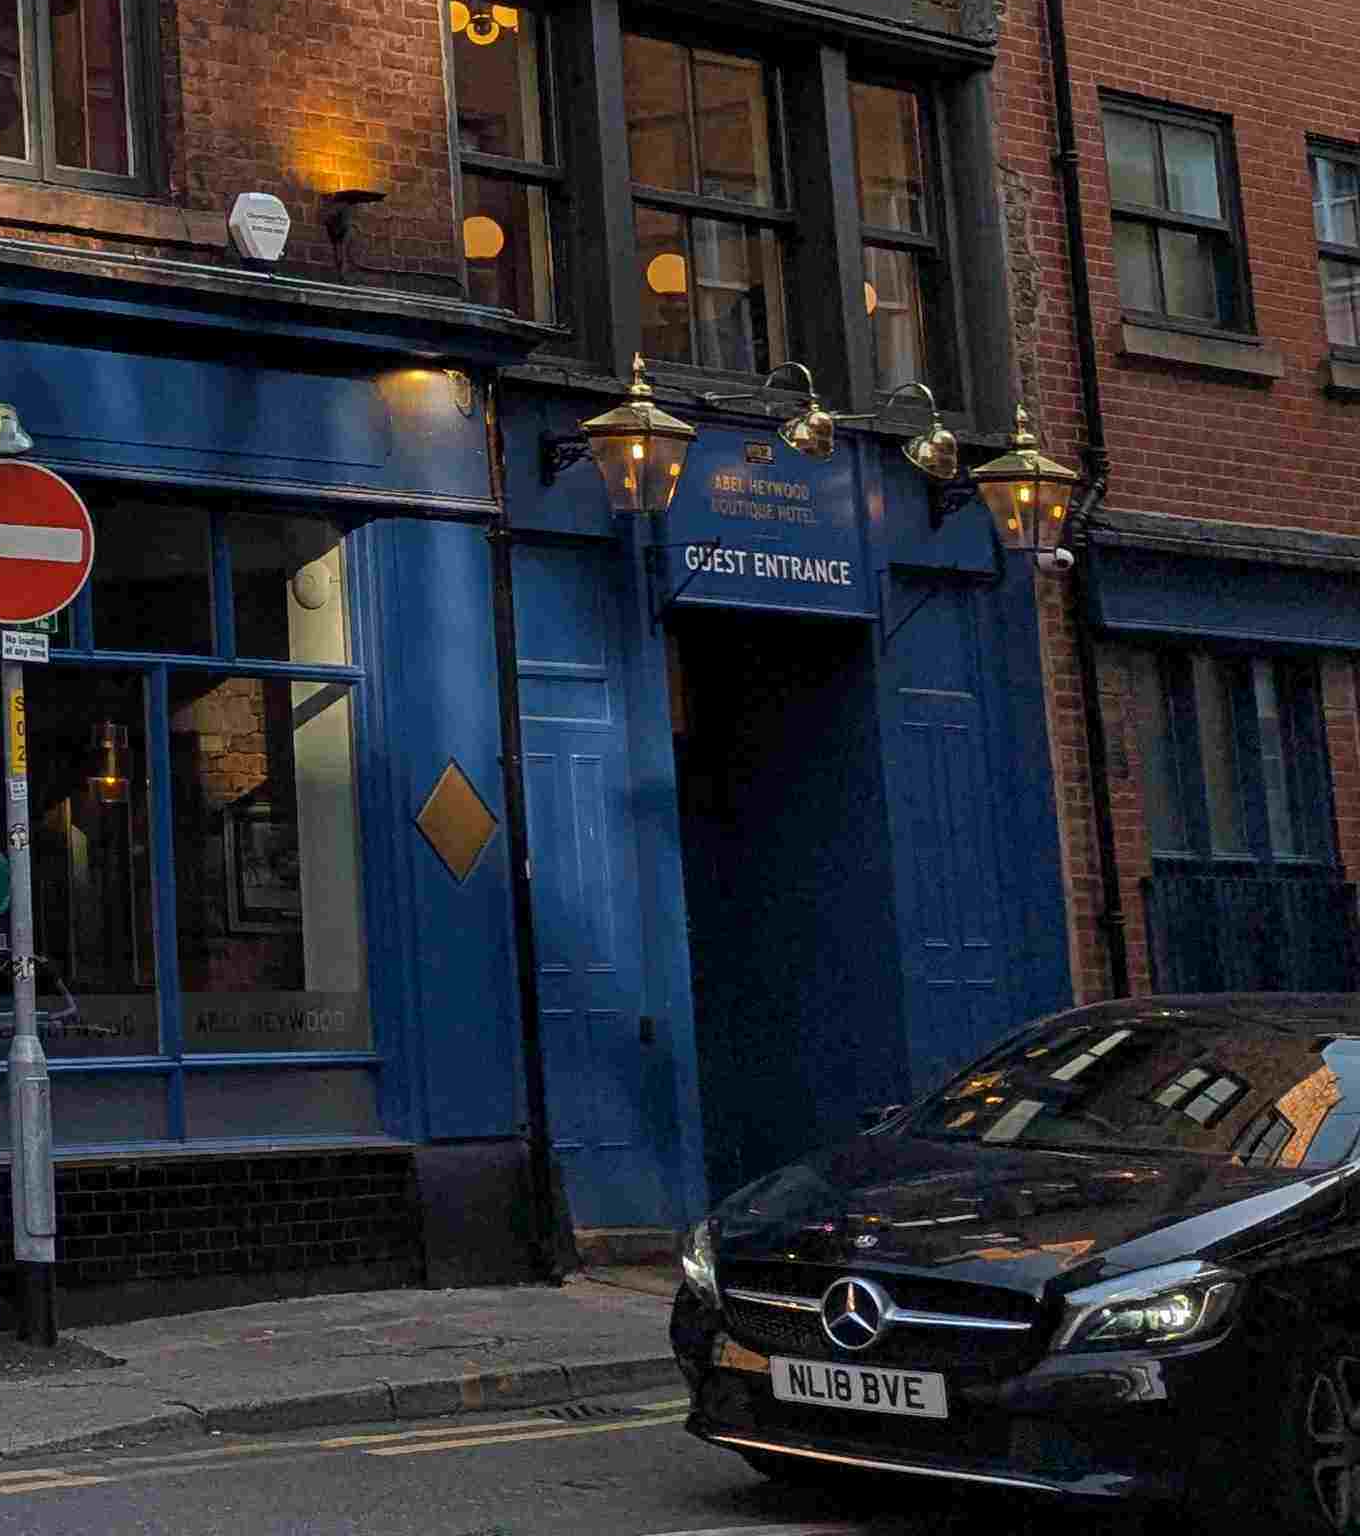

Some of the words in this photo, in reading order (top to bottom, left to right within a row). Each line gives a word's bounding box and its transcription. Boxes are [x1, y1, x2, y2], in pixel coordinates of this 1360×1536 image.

[712, 472, 745, 494] ABEL
[750, 479, 810, 499] HEYWOOD
[685, 545, 747, 575] GUEST
[753, 553, 852, 585] ENTRANCE
[788, 1363, 852, 1402] NL18
[860, 1371, 926, 1410] BVE
